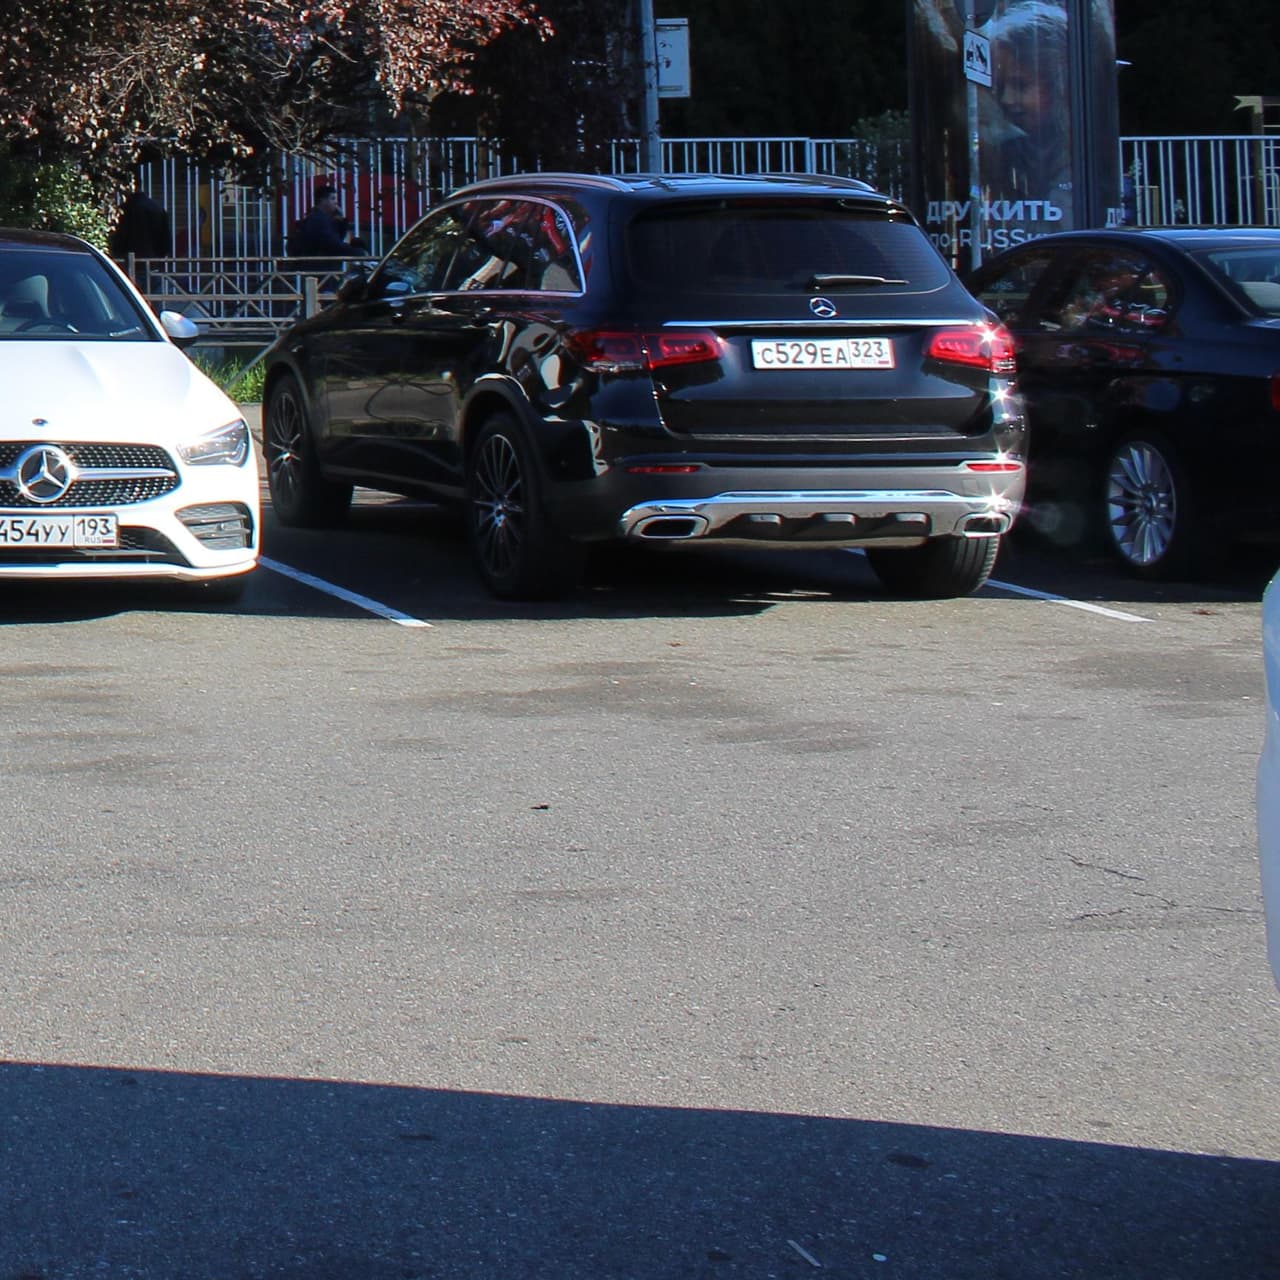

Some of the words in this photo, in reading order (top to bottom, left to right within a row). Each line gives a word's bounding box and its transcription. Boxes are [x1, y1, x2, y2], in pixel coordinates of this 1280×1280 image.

[761, 342, 849, 365] С529ЕА
[850, 341, 884, 358] 323
[76, 517, 113, 536] 193
